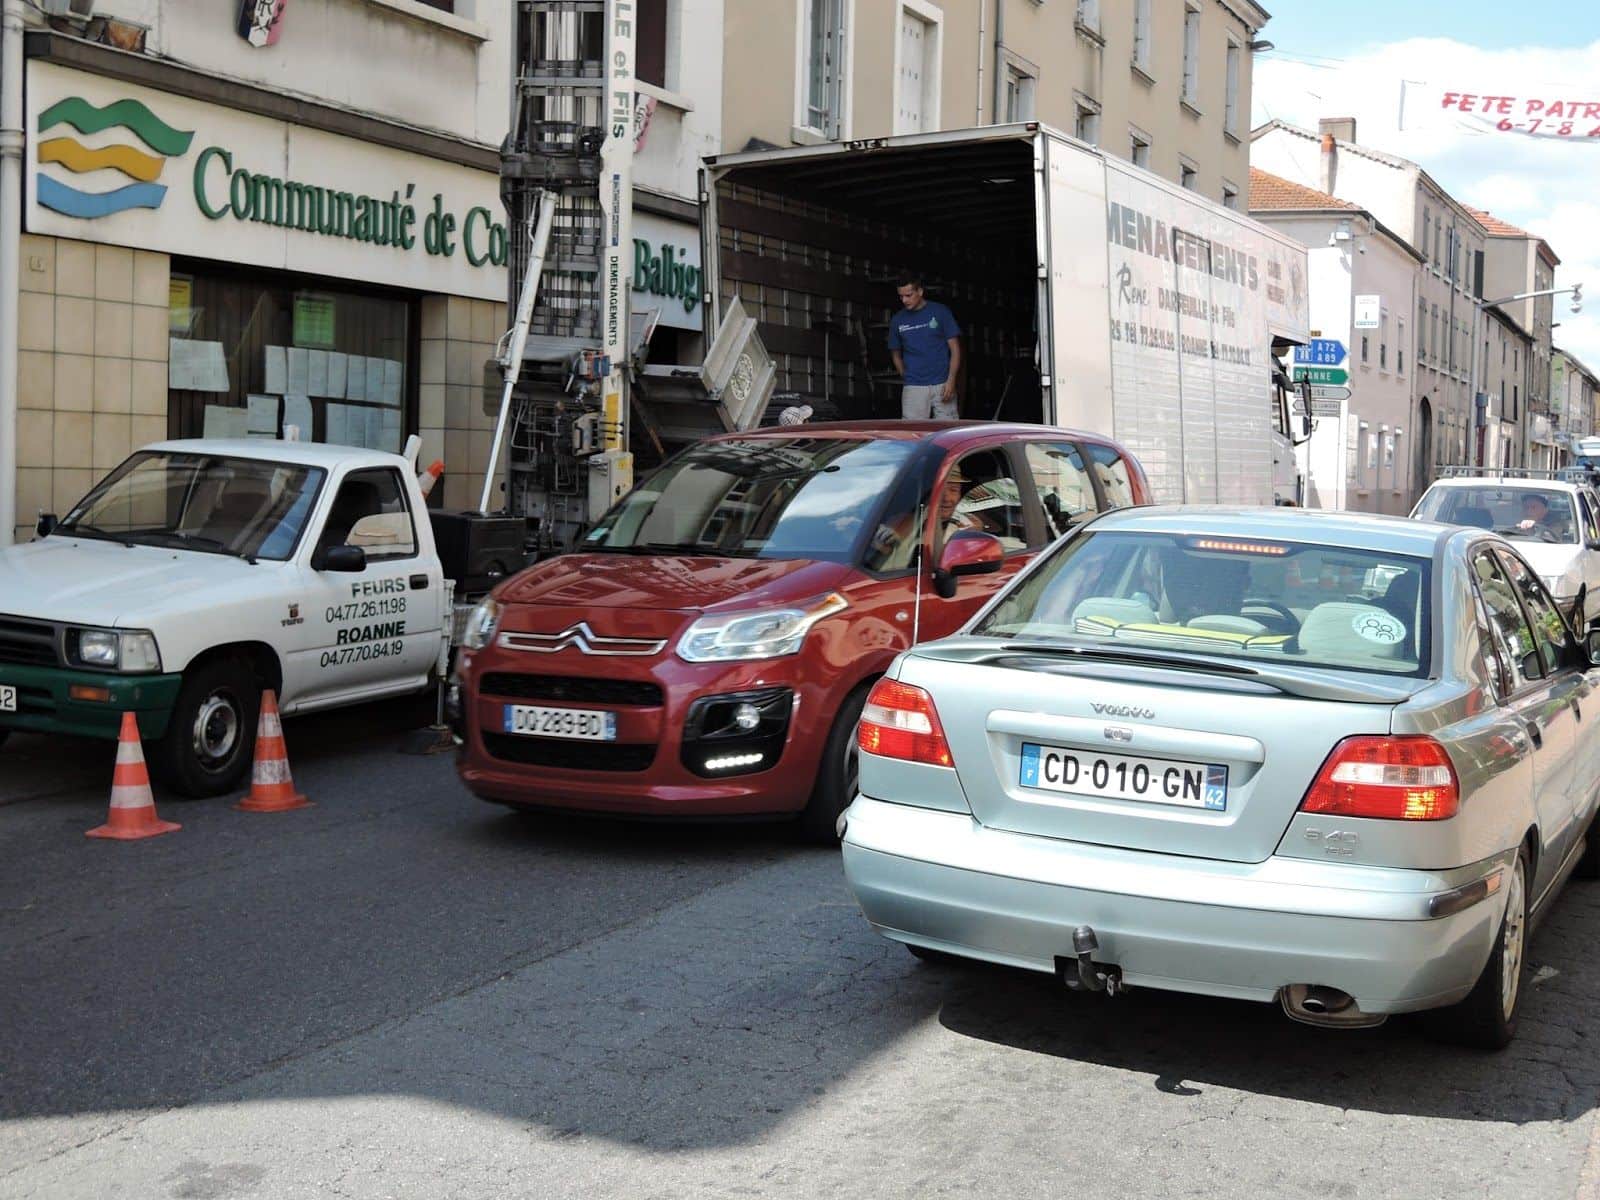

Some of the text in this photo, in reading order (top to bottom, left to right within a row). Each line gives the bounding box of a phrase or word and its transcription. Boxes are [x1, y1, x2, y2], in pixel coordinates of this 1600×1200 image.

[613, 0, 631, 139] LE et Fils
[1442, 92, 1516, 114] FETE
[194, 147, 416, 250] Communauté
[424, 194, 456, 257] de
[608, 255, 618, 346] DEMENAGEMENTS
[352, 577, 406, 598] FEURS
[325, 598, 406, 623] 04.77.26.11.98
[336, 620, 406, 646] ROANNE
[320, 640, 404, 668] 04.77.70.84.19
[1090, 702, 1155, 719] VOLVO
[1206, 788, 1224, 806] 42
